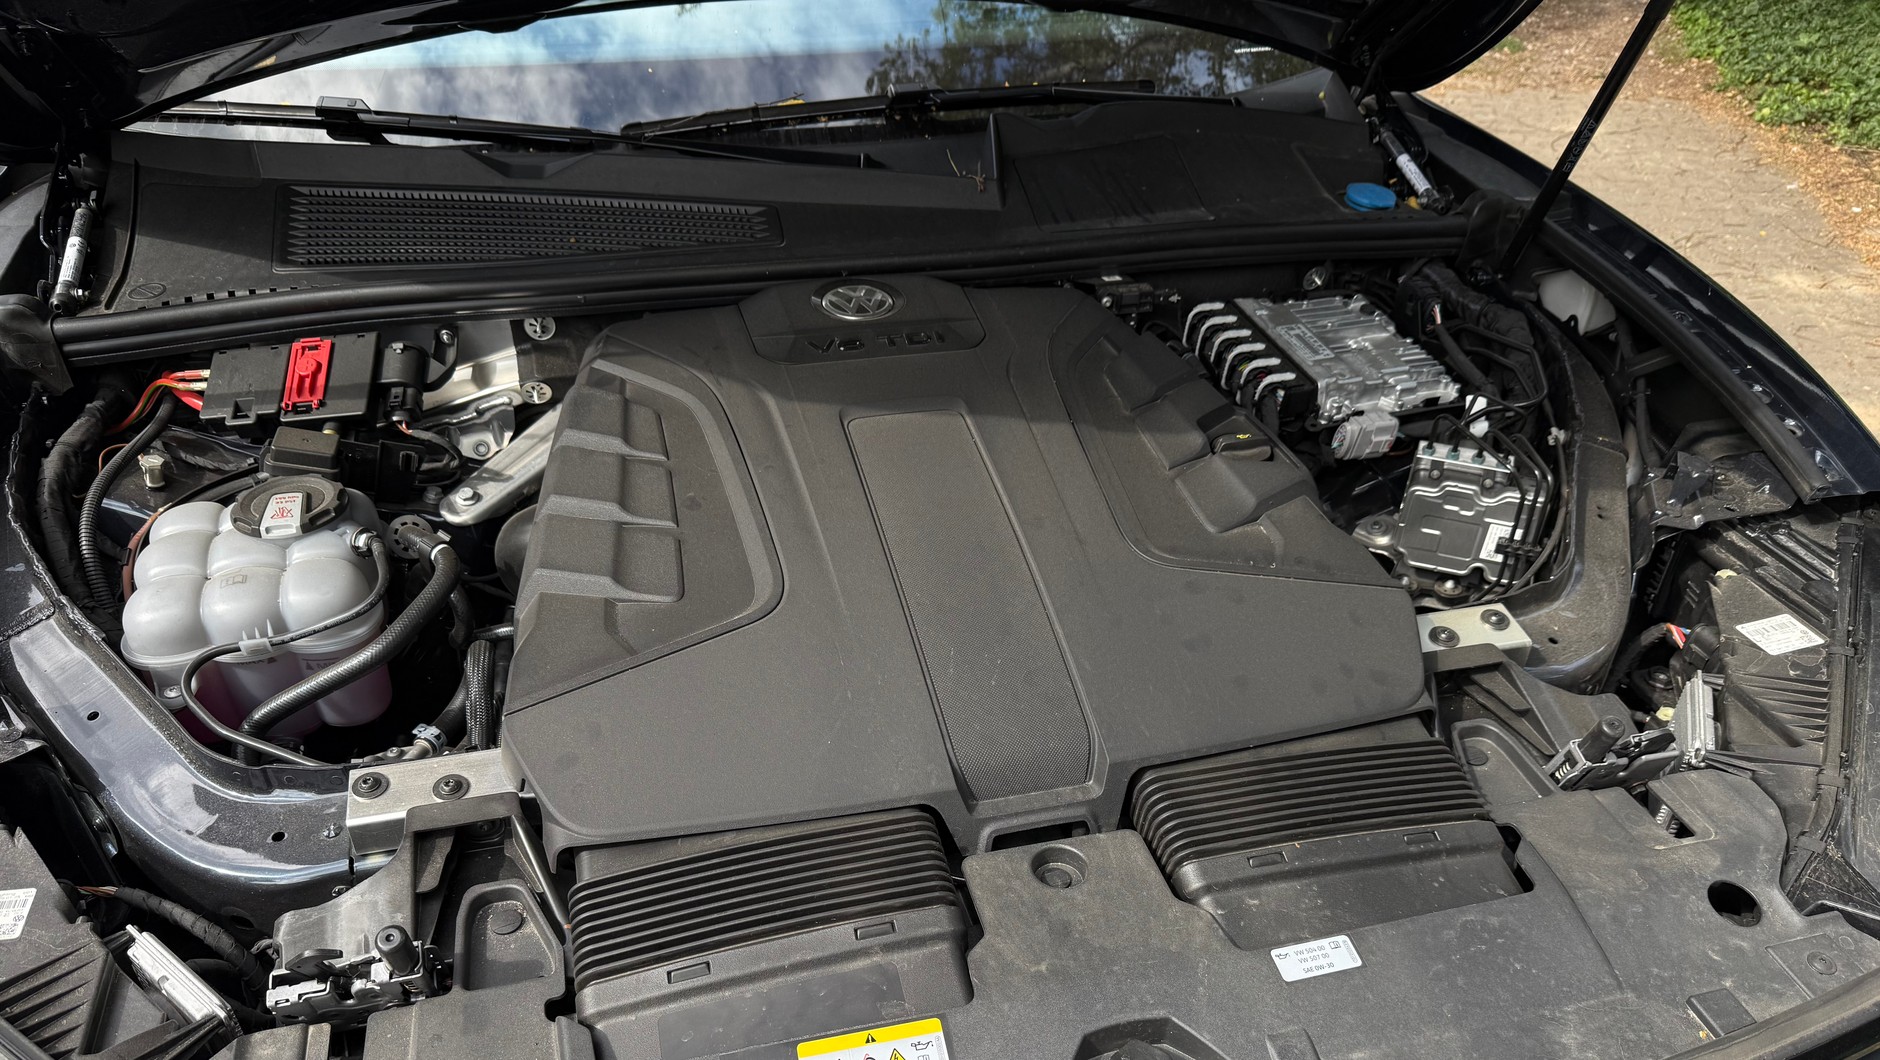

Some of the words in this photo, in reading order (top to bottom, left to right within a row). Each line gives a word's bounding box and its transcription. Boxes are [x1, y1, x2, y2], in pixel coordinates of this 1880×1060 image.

[805, 336, 865, 354] V6
[876, 330, 946, 347] TDI
[1309, 954, 1321, 962] 507
[1315, 962, 1335, 971] 0W-30
